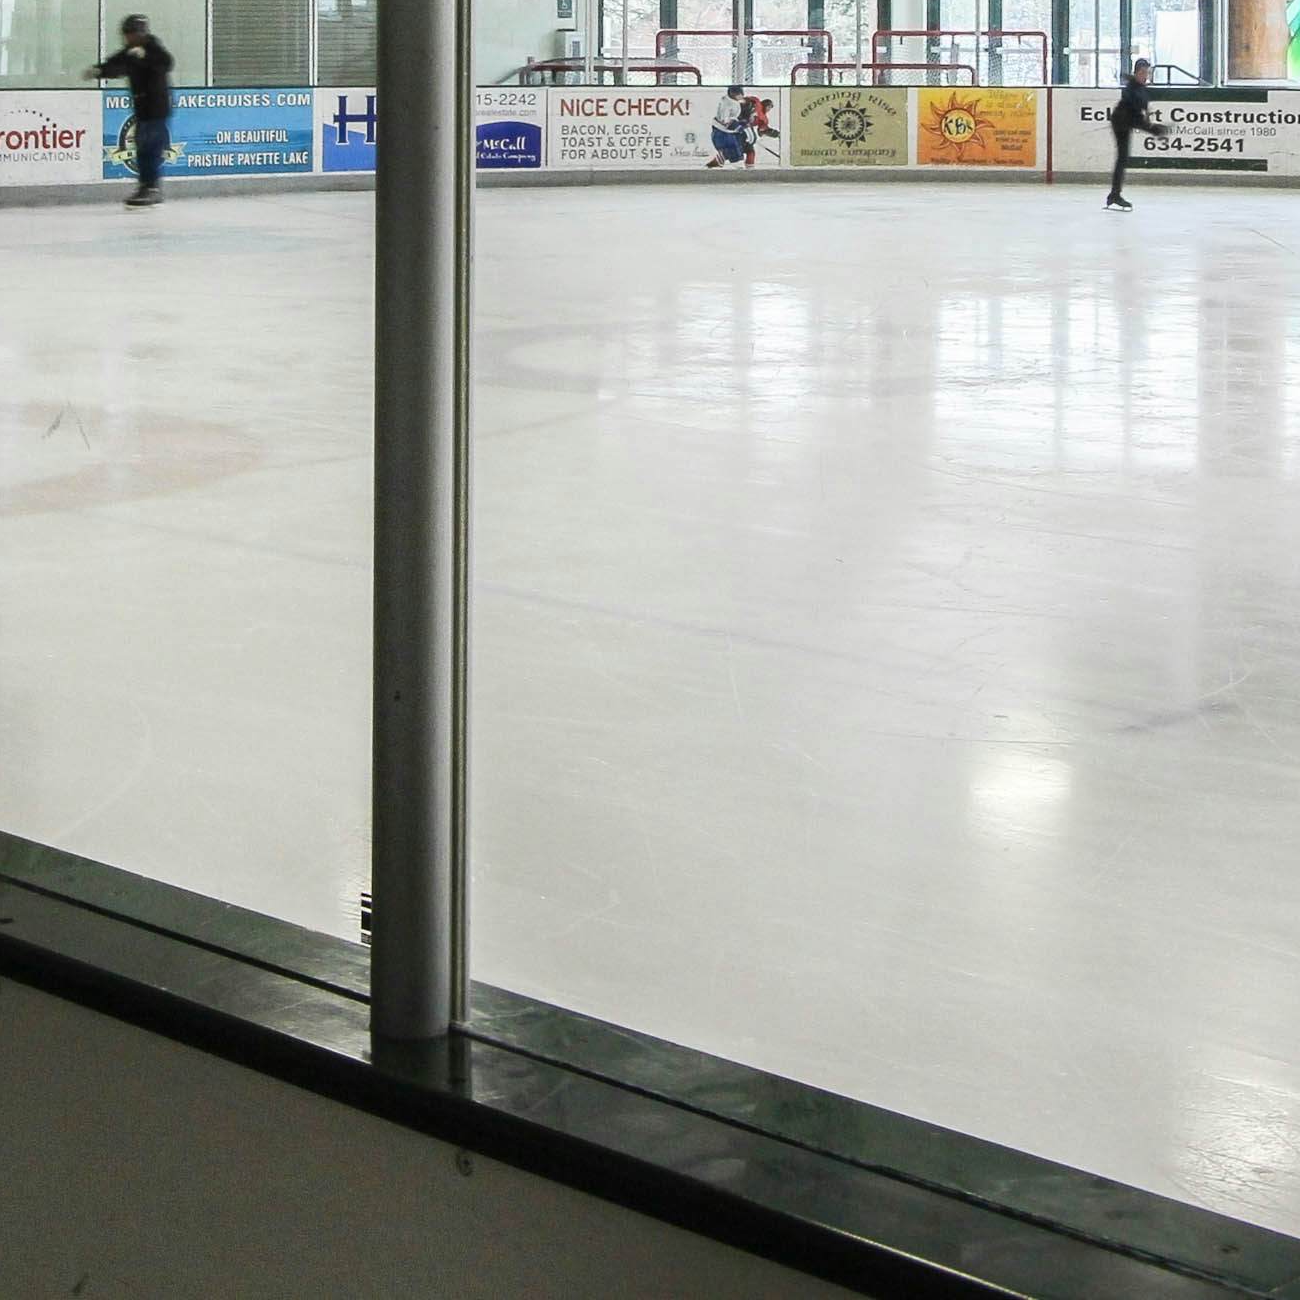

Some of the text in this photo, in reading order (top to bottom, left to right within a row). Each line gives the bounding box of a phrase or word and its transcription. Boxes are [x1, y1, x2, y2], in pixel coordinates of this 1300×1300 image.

[476, 93, 537, 106] 15-2242
[560, 97, 691, 117] NICE CHECK!
[233, 130, 289, 143] BEAUTIFUL
[561, 124, 652, 137] BACON, EGGS,
[1176, 126, 1214, 136] McCall
[1217, 127, 1246, 137] since
[1250, 127, 1277, 137] 1980
[561, 136, 670, 147] TOAST & COFFEE
[1144, 137, 1245, 153] 634-2541
[187, 151, 309, 168] PRISTINE PAYETTE LAKE
[561, 148, 663, 160] FOR ABOUT $15
